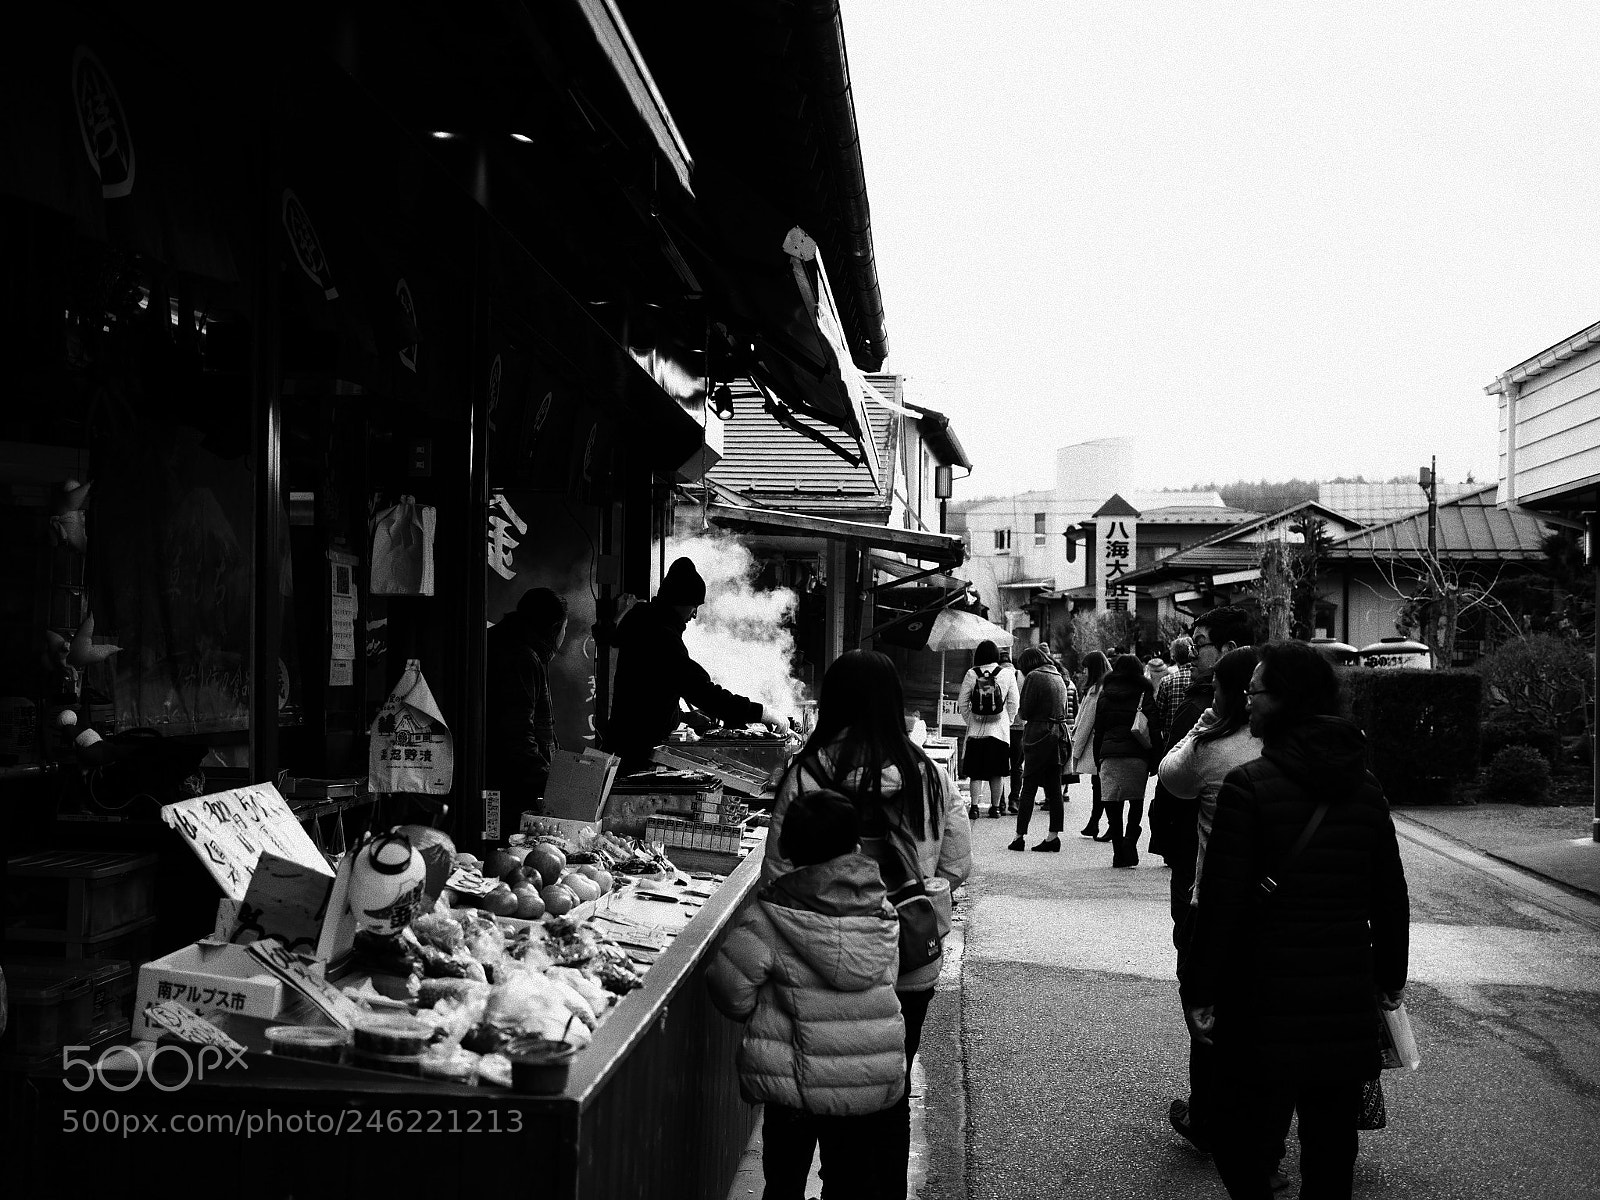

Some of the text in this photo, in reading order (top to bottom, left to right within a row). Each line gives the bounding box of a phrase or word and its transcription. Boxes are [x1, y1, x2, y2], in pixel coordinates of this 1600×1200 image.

[157, 980, 248, 1011] 南アルプス市
